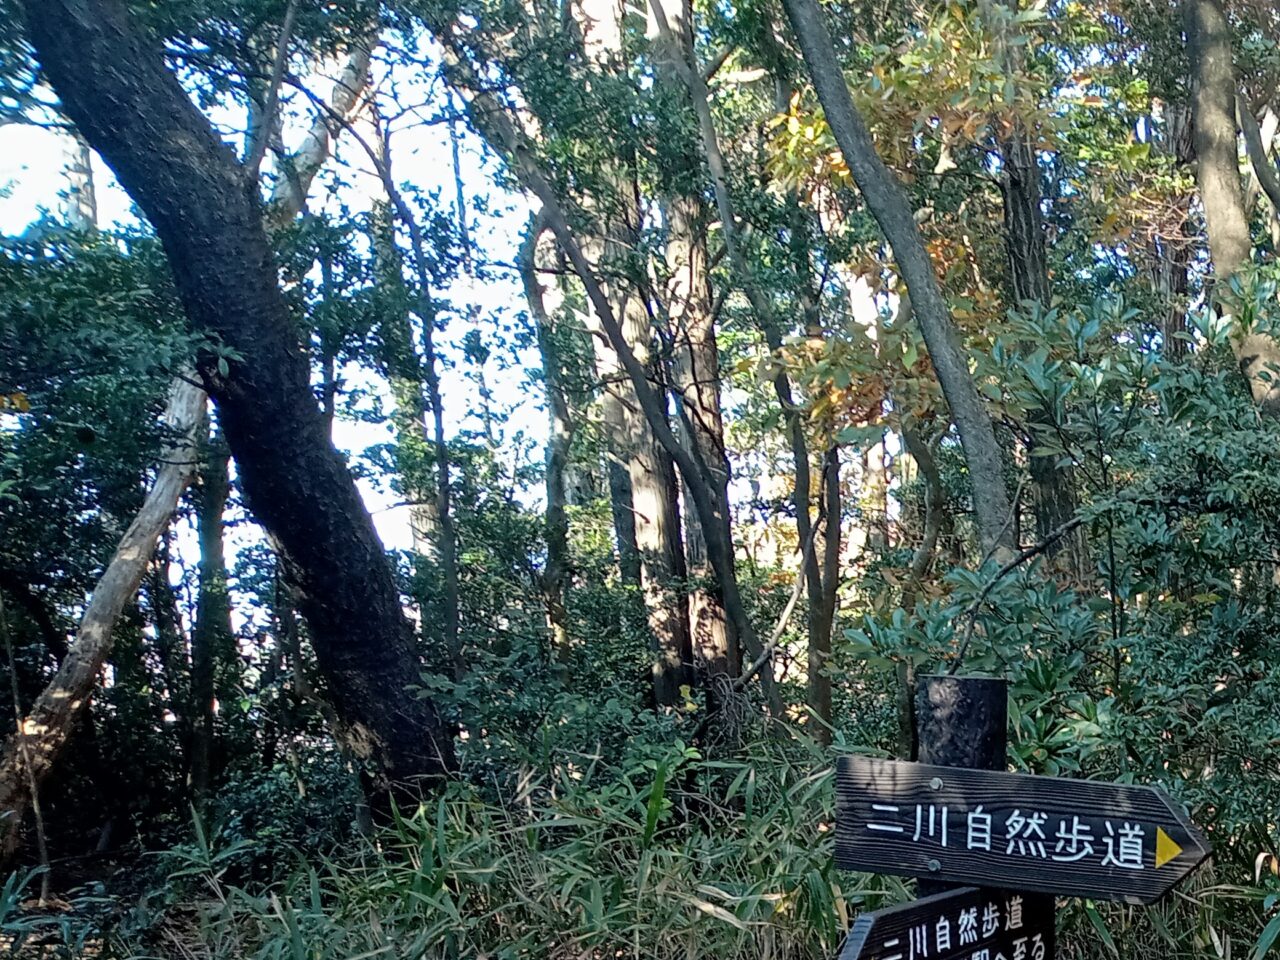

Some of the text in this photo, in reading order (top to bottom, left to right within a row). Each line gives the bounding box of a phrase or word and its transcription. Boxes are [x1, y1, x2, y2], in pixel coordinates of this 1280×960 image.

[866, 804, 1146, 869] 二川自然歩道
